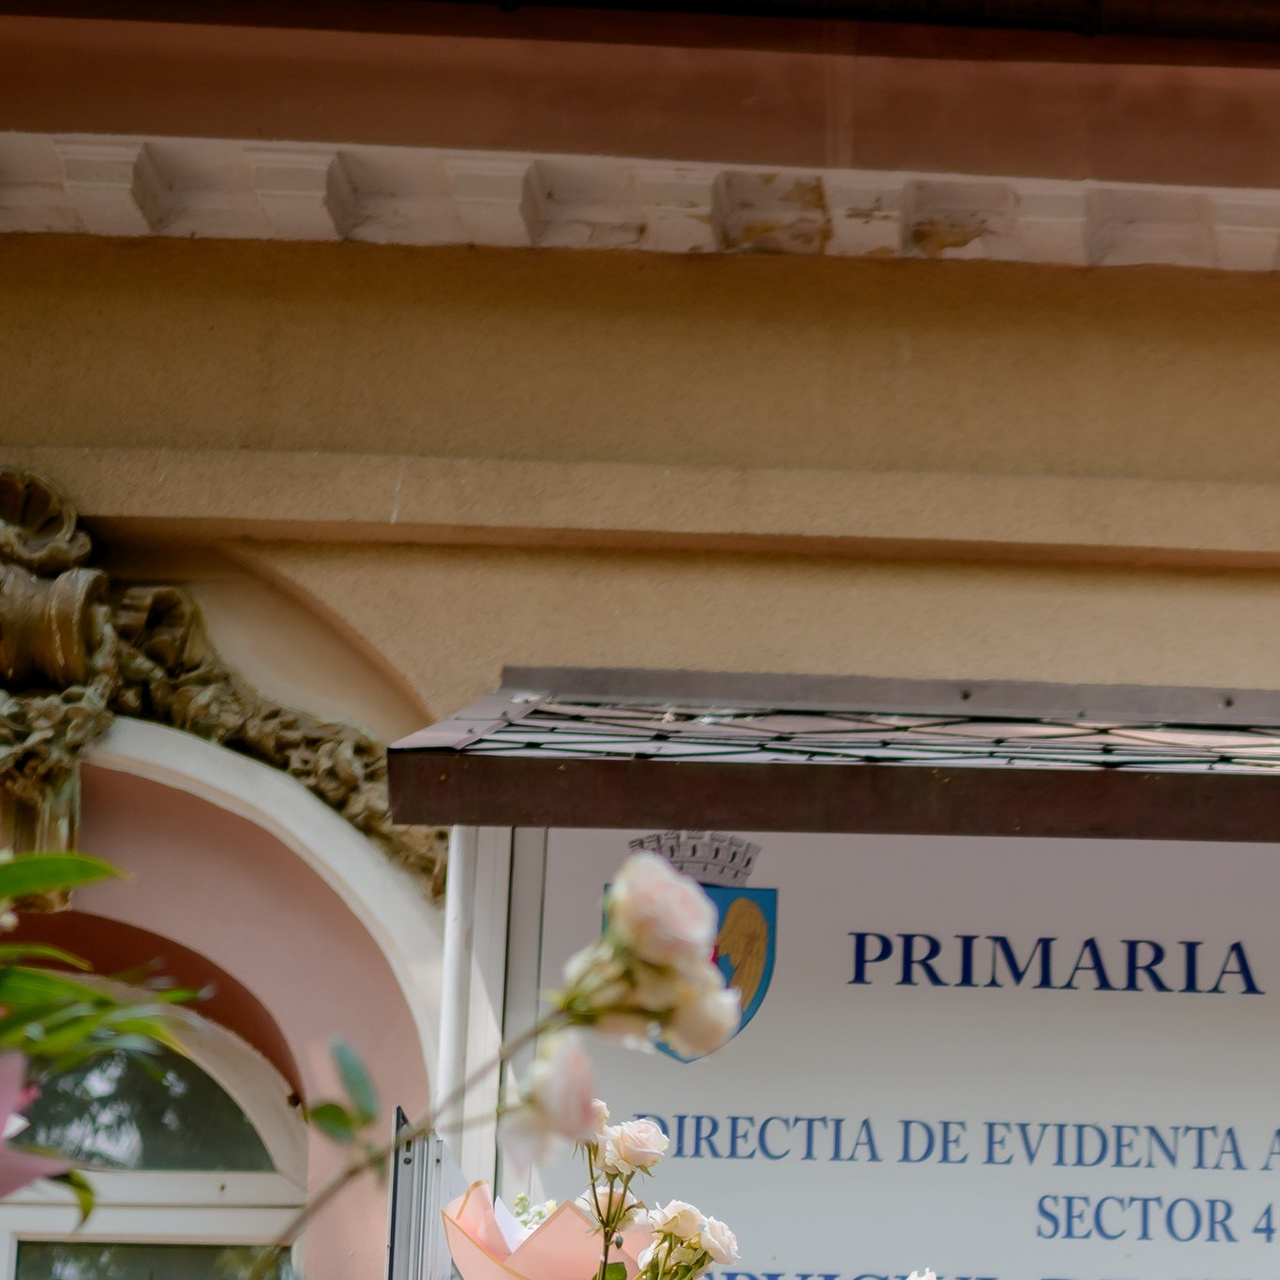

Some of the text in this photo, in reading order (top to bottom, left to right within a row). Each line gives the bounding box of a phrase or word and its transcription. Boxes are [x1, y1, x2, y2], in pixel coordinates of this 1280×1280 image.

[848, 931, 1265, 996] PRIMARIA
[899, 1119, 969, 1166] DE
[982, 1121, 1248, 1172] EVIDENTA
[1036, 1195, 1277, 1244] SECTOR 4
